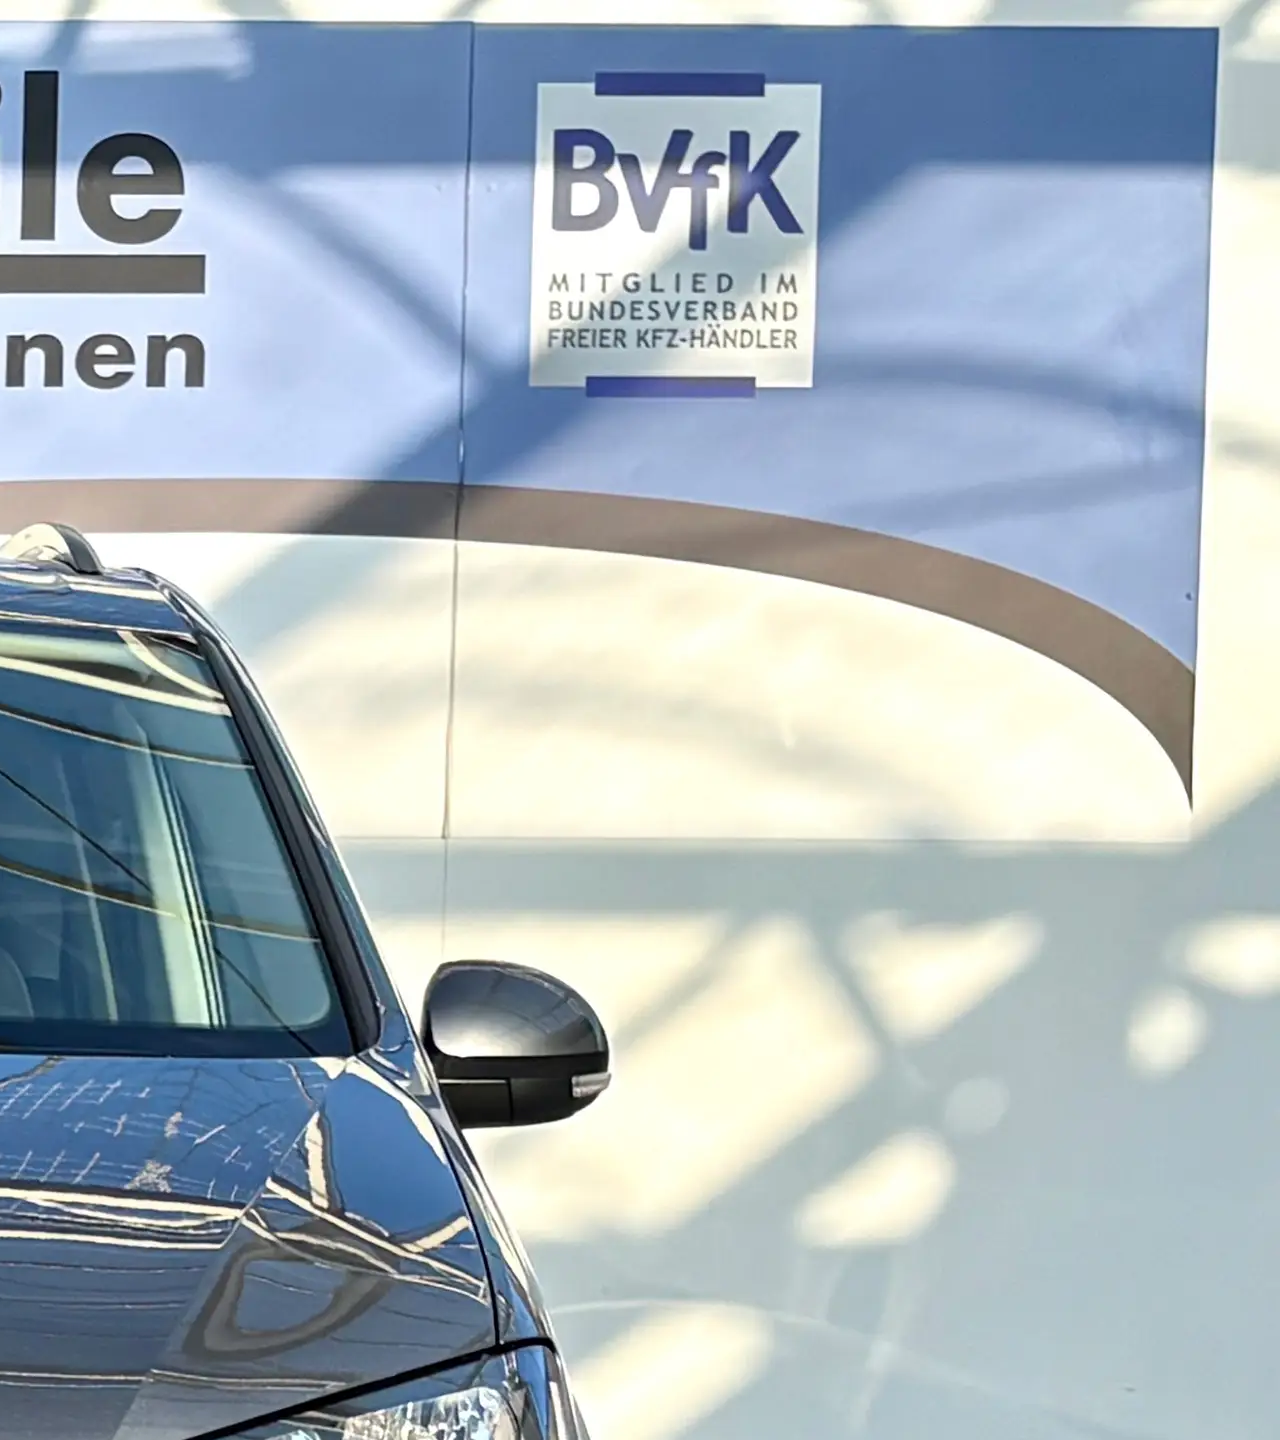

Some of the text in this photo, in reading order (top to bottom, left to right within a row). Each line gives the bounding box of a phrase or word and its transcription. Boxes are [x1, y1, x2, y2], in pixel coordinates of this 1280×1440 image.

[549, 272, 798, 294] MITGLIED IM
[549, 300, 798, 322] BUNDESVERBAND
[547, 323, 798, 350] FREIER KFZ-HÄNDLER
